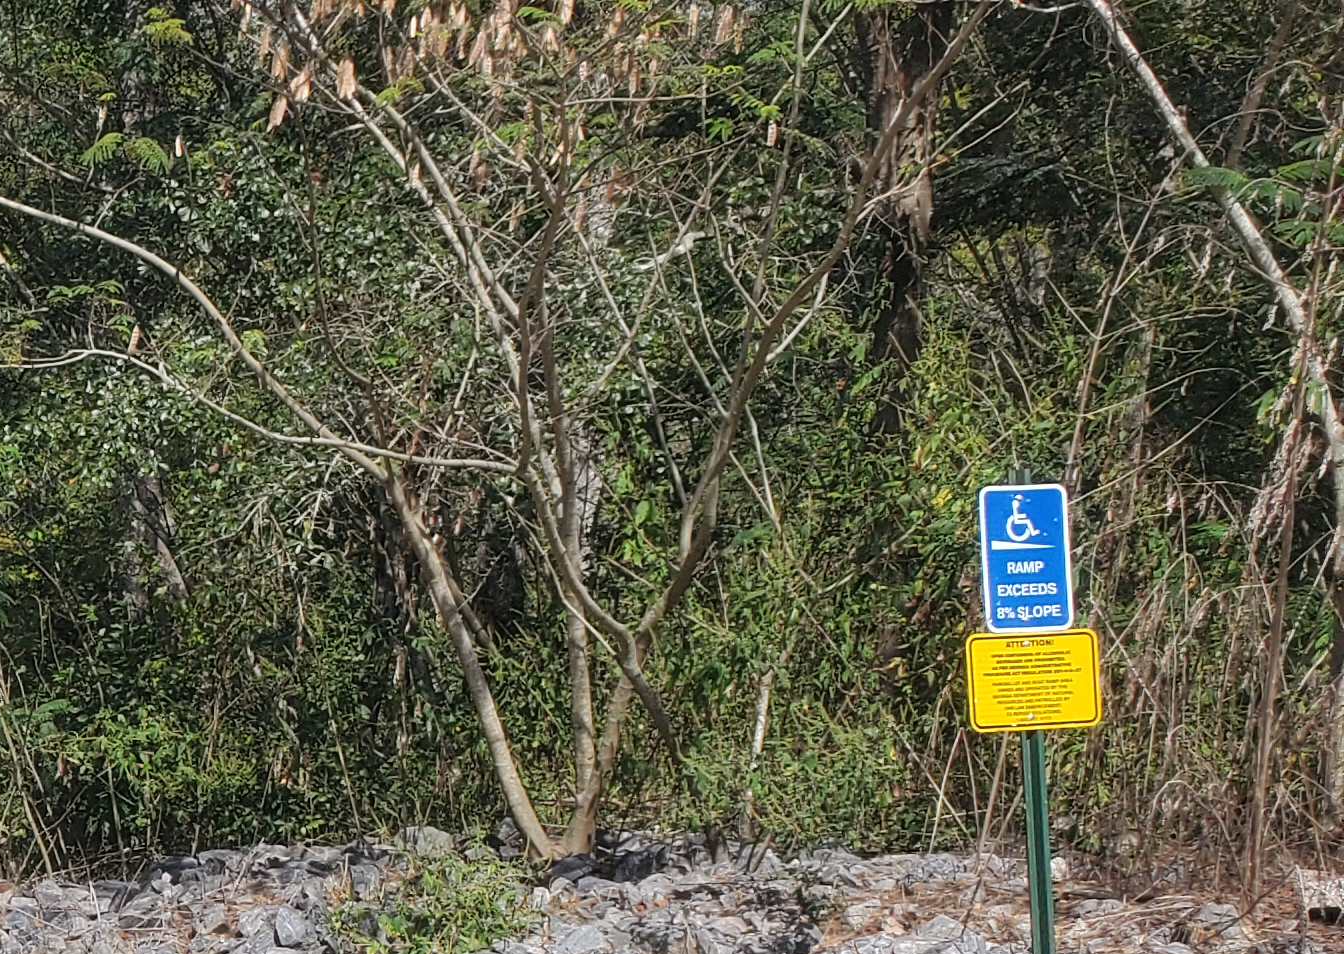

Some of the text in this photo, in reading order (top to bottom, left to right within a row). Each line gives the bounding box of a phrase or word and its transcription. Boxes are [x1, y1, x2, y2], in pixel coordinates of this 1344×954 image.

[1007, 560, 1045, 574] RAMP
[997, 582, 1058, 596] EXCEEDS
[996, 604, 1062, 619] 8% SLOPE
